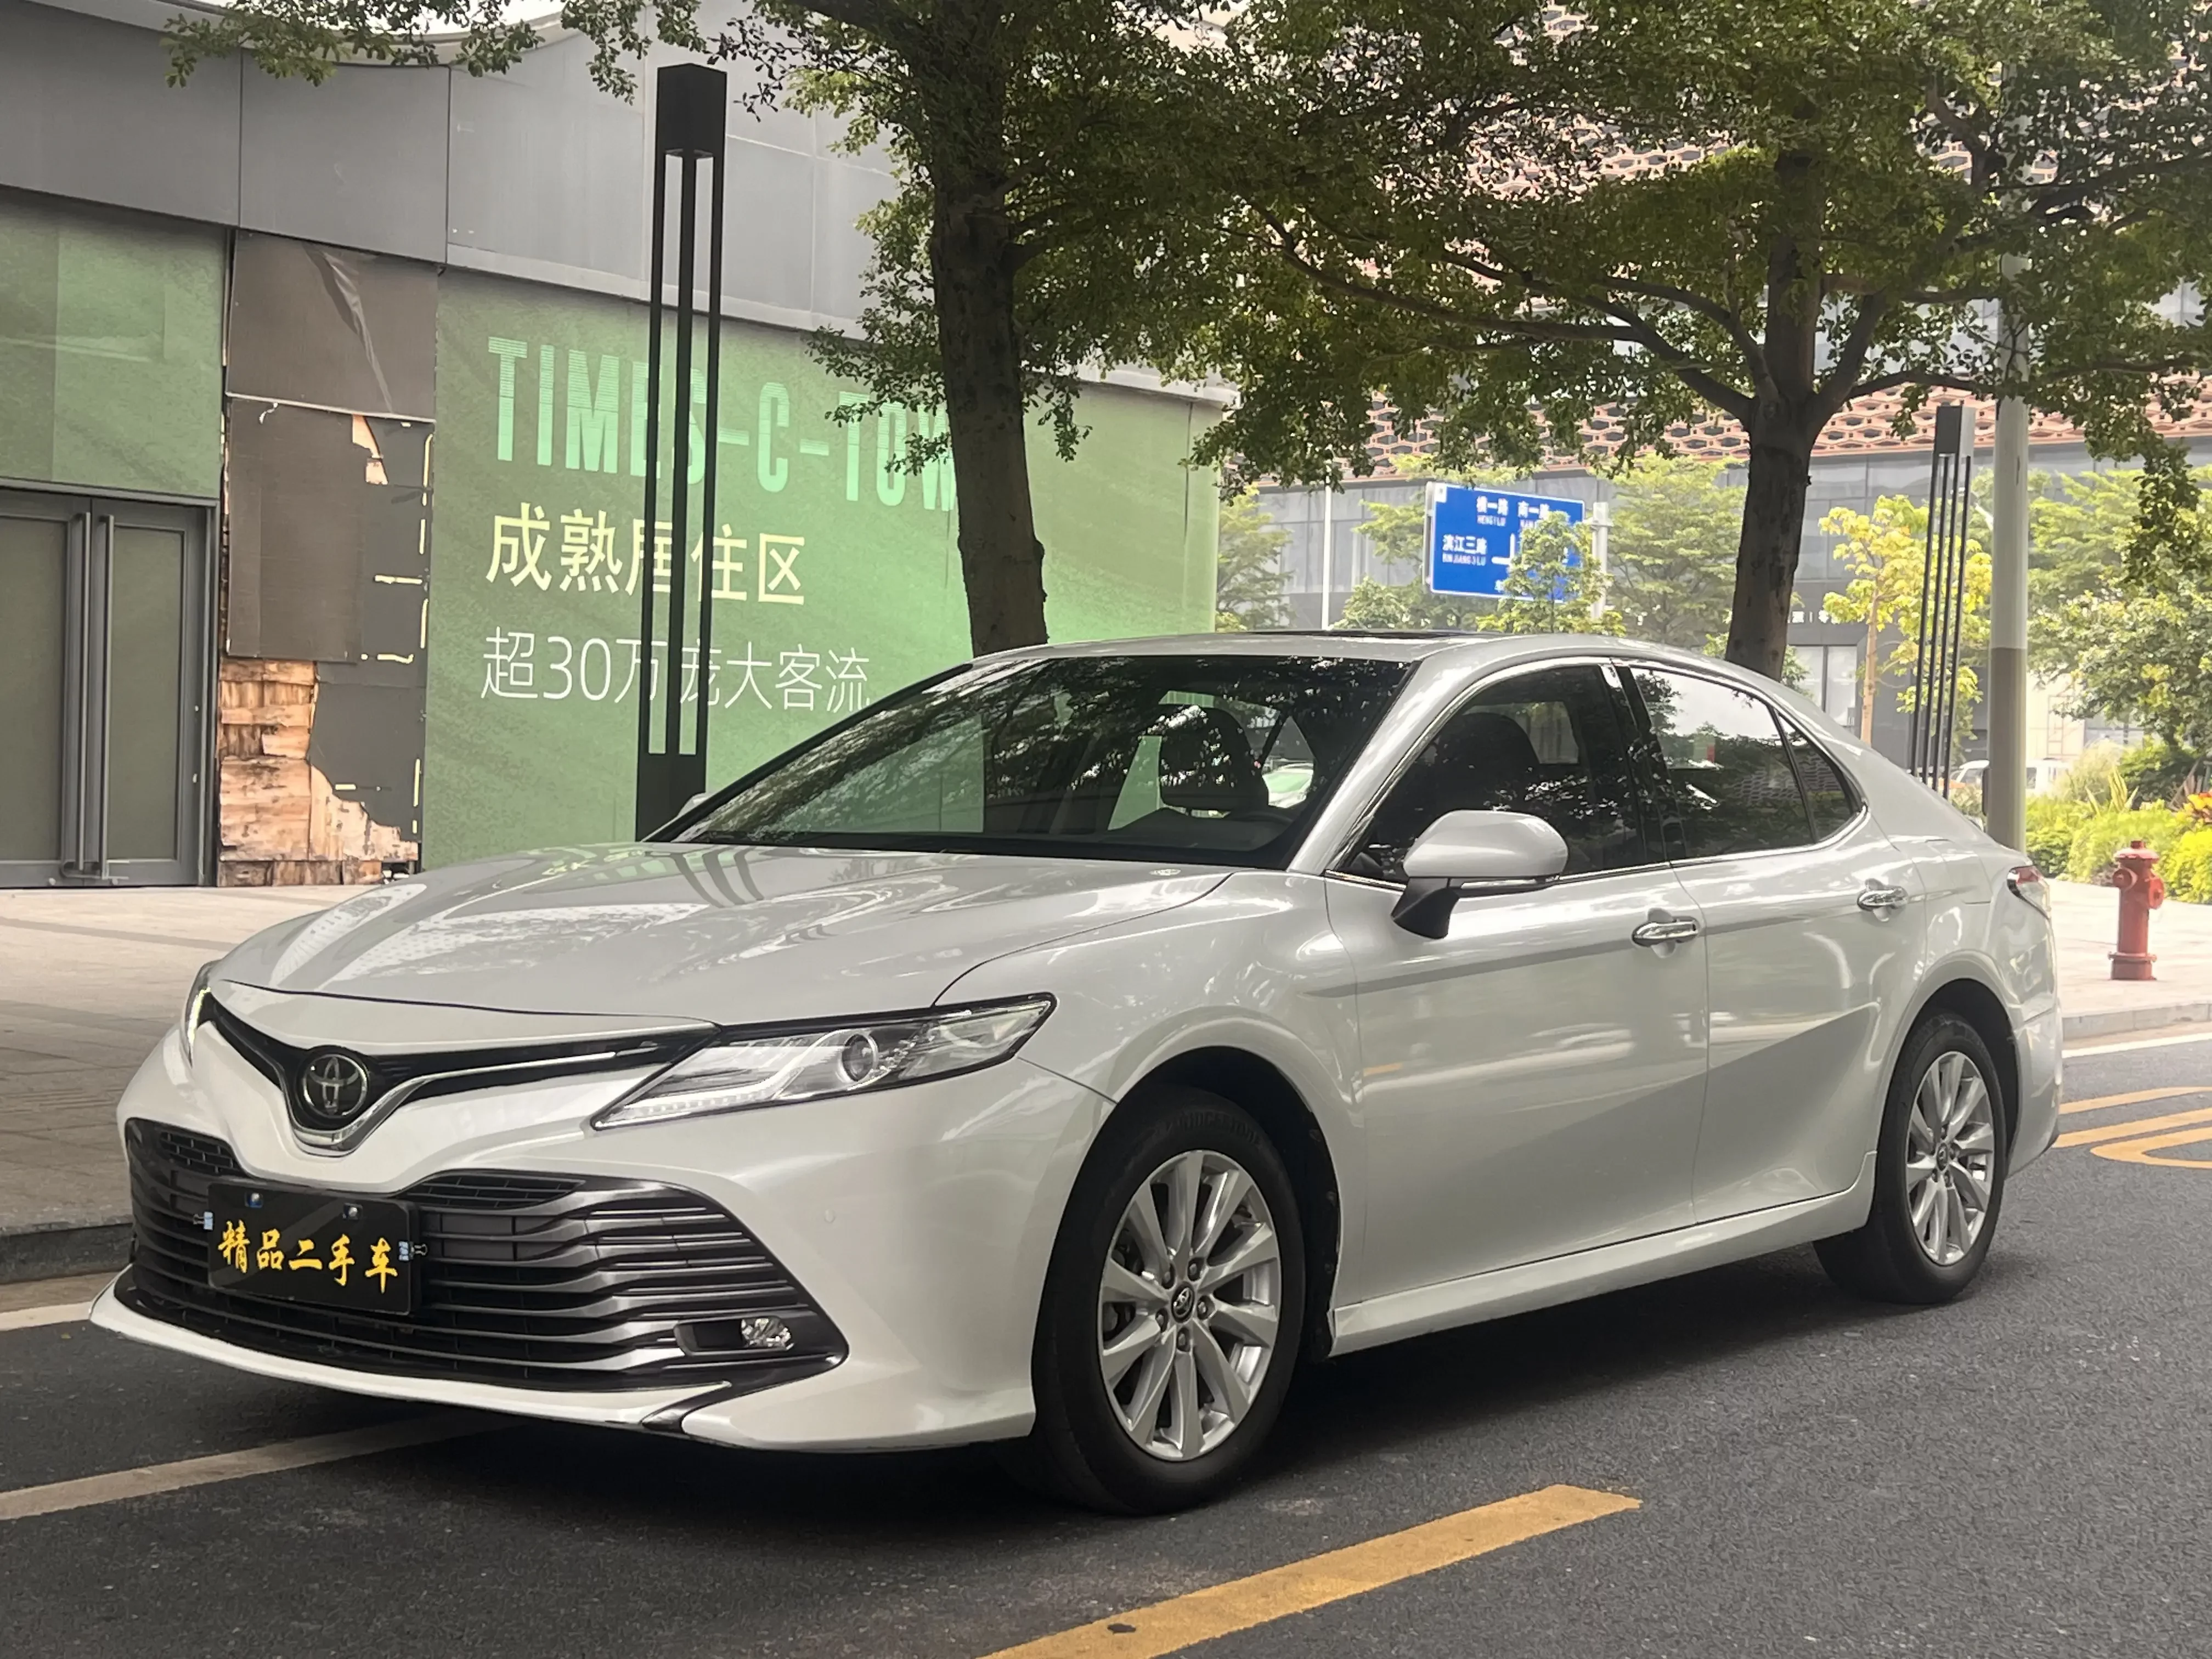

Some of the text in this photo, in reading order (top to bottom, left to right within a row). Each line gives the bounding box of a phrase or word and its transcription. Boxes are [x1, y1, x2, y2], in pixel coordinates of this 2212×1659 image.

[486, 503, 805, 604] 成熟居住区
[481, 626, 870, 713] 超30万庞大客流
[218, 1219, 398, 1294] 精品二手车
